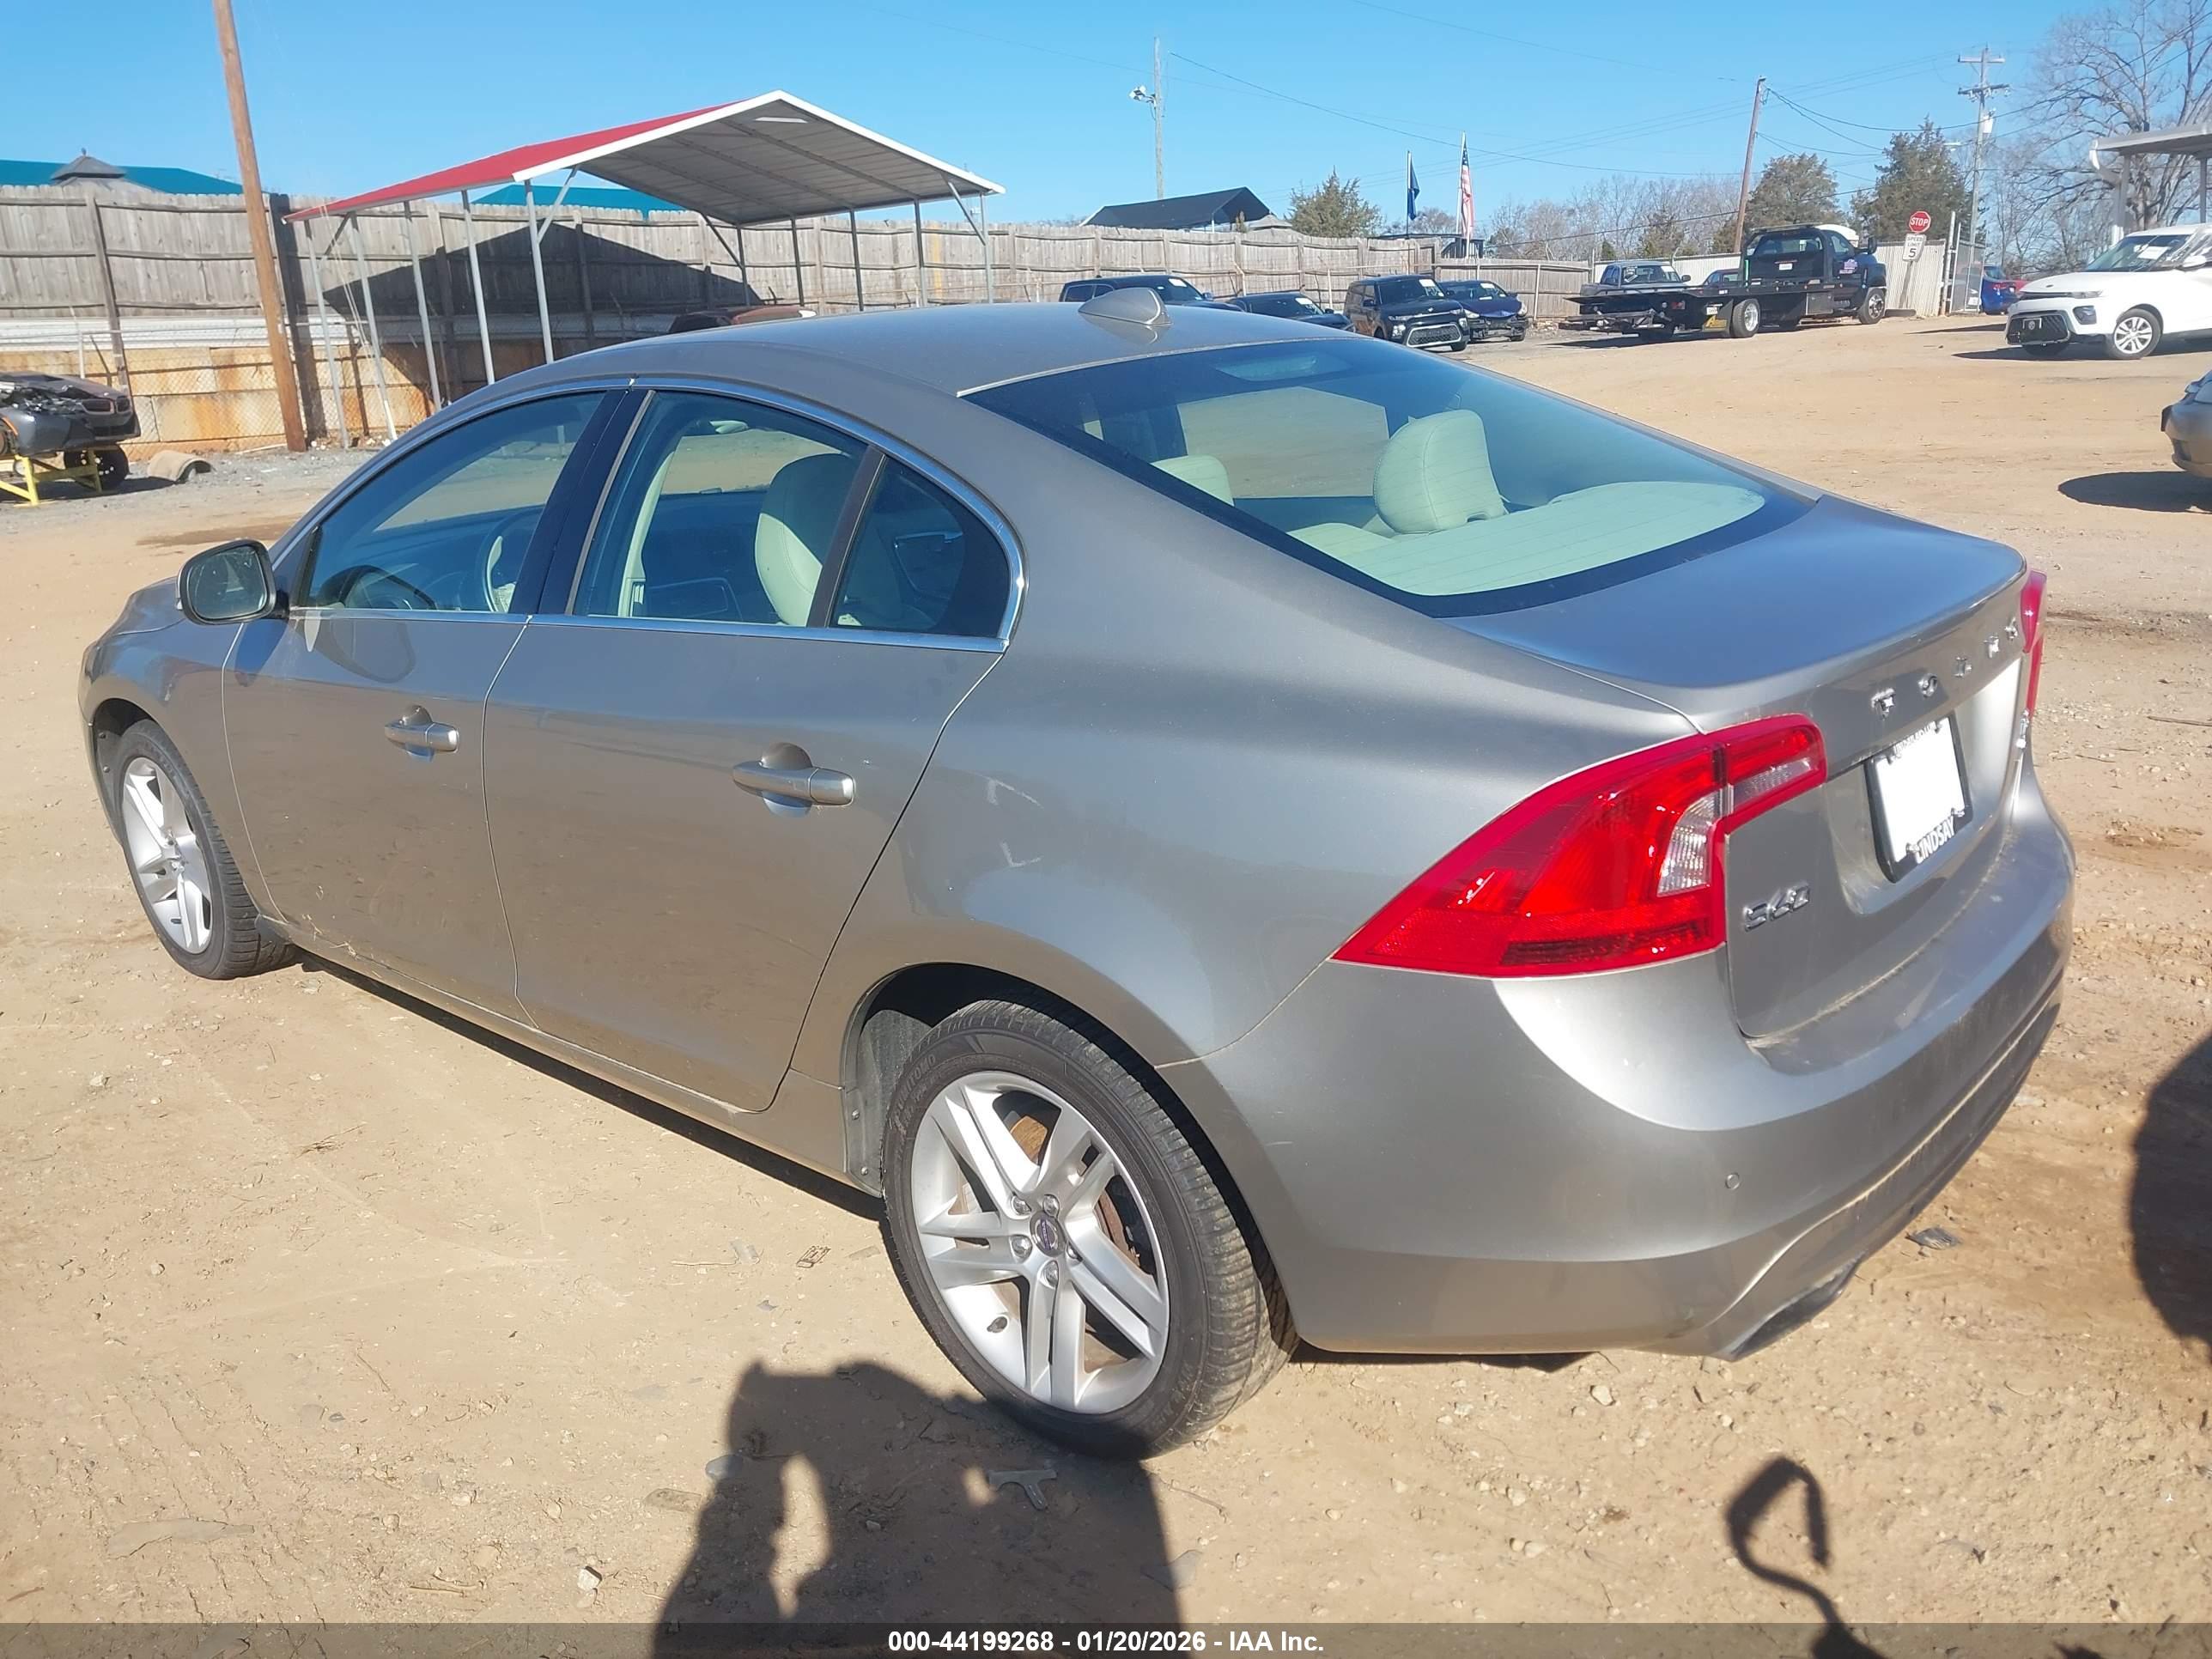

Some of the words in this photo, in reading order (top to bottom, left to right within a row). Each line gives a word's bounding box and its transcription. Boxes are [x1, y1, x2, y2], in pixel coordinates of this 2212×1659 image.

[1911, 216, 1929, 227] STOP
[1908, 248, 1917, 258] 5
[1914, 816, 1956, 865] LINDSAY
